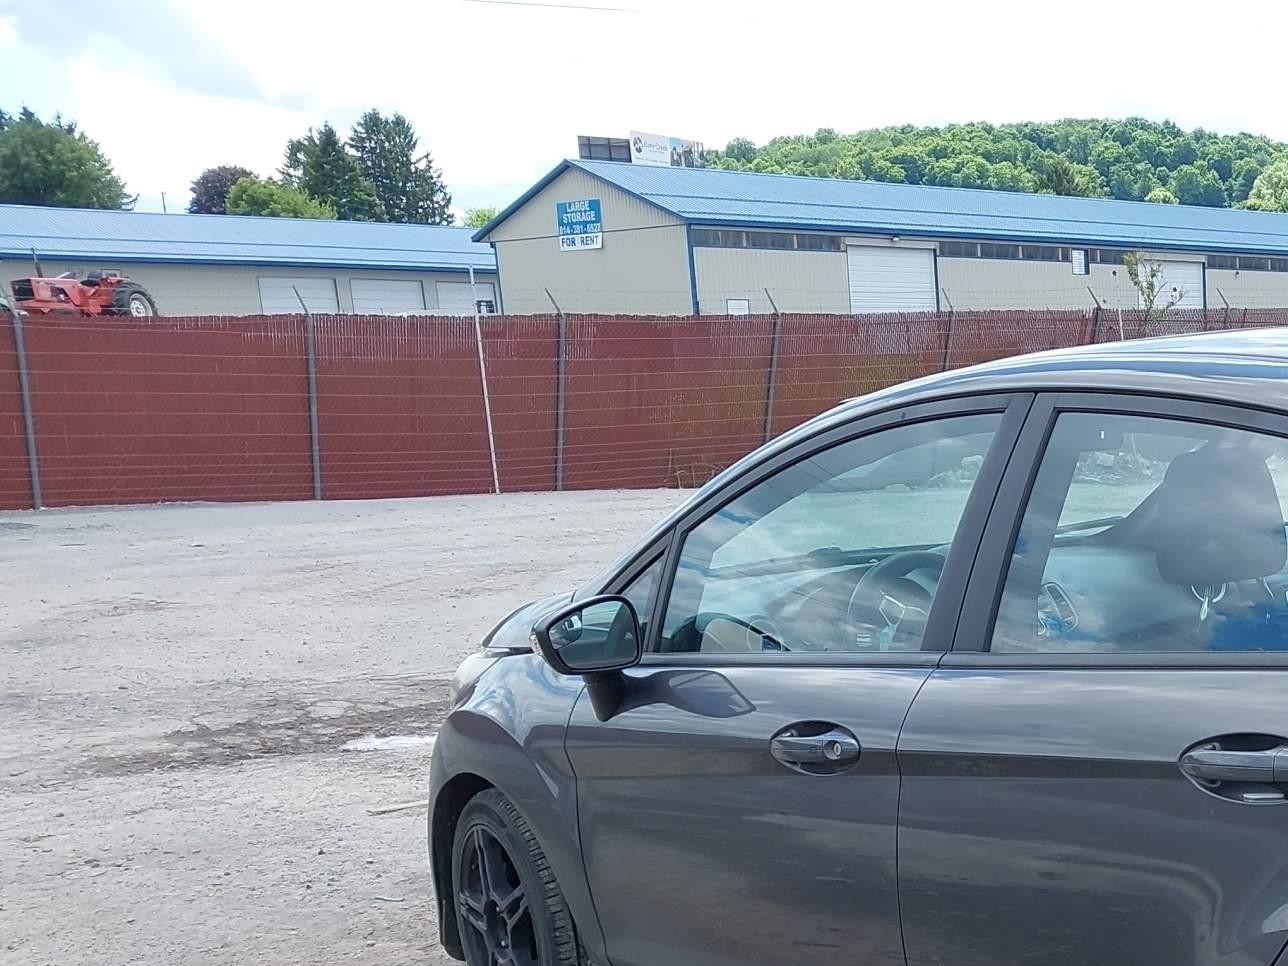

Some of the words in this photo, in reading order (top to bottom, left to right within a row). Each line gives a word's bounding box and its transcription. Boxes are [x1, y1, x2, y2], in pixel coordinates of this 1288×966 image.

[566, 201, 590, 212] LARGE
[562, 211, 595, 223] STORAGE
[561, 237, 576, 247] FOR
[580, 235, 599, 246] RENT
